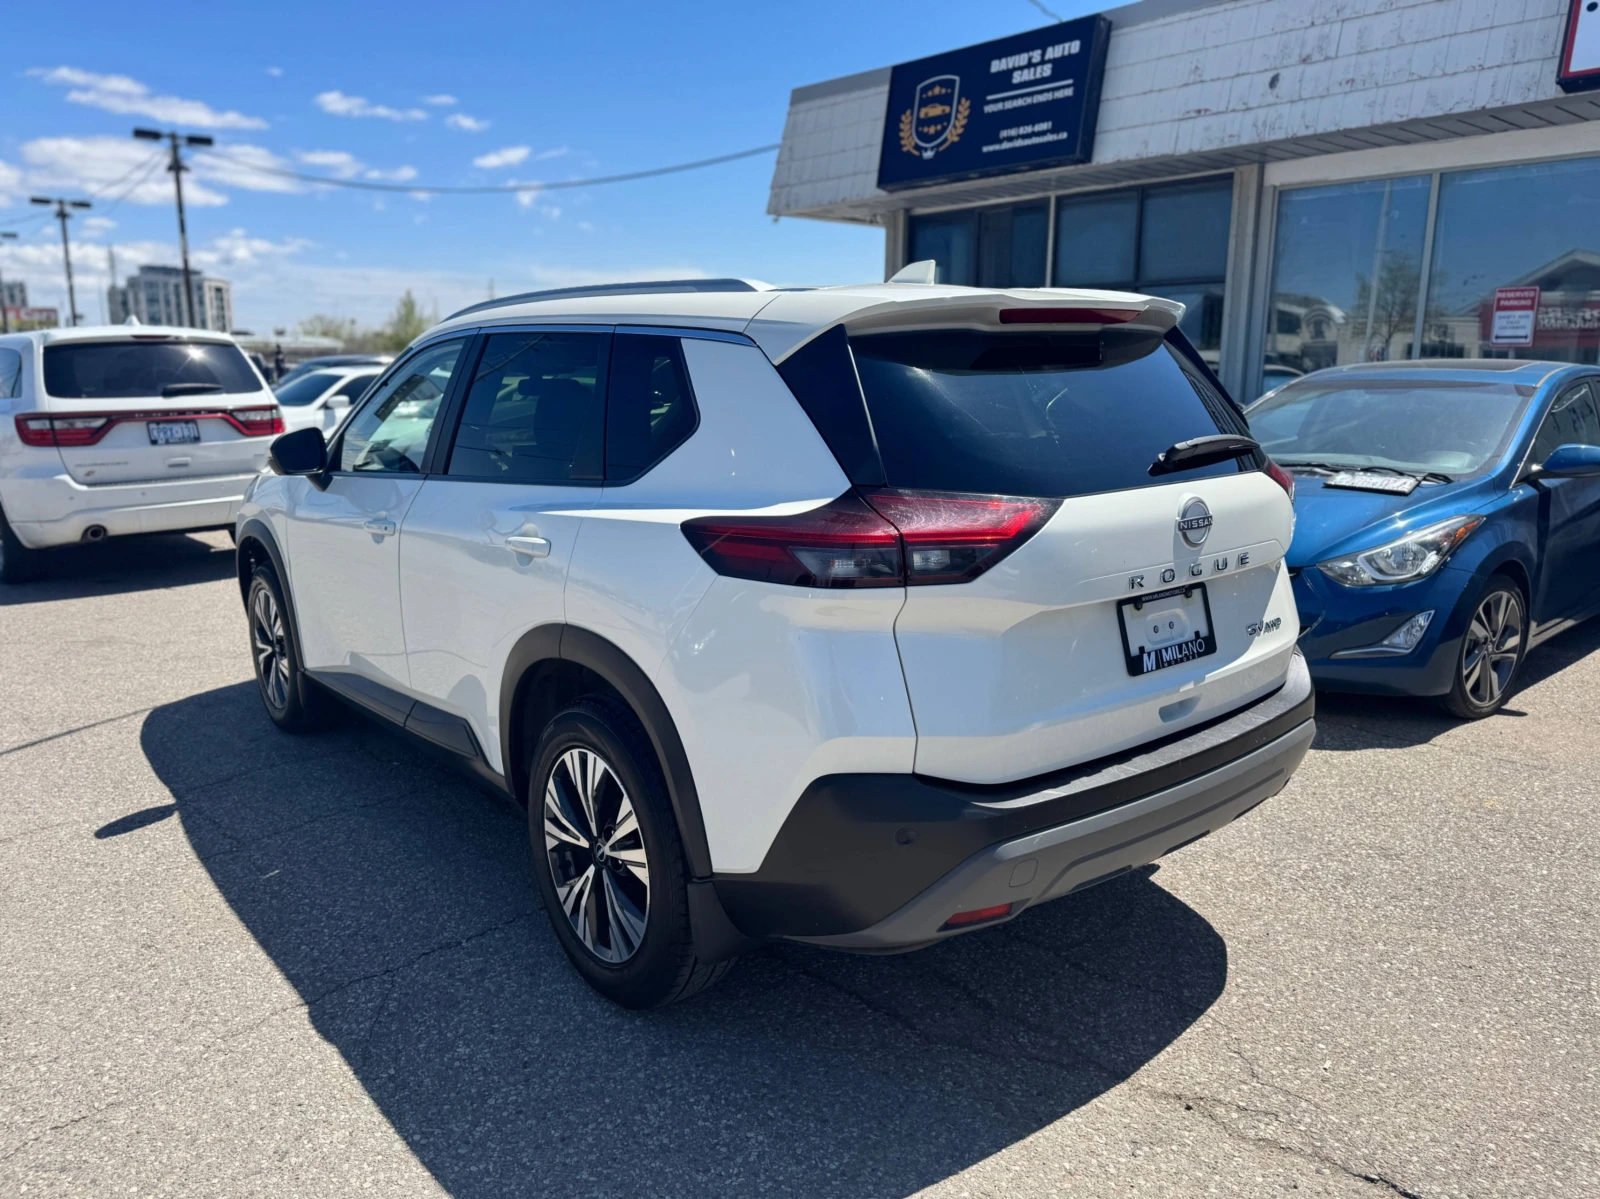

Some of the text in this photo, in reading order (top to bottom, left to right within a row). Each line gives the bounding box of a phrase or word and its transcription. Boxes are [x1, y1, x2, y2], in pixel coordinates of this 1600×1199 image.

[990, 40, 1080, 73] DAVID'S AUTO
[1012, 63, 1052, 84] SALES
[983, 86, 1074, 114] YOUR SEARCH ENDS HERE
[1496, 290, 1535, 299] RESERVED
[1500, 299, 1532, 307] PARKING
[1179, 516, 1213, 531] NISSAN
[1128, 552, 1249, 590] ROGUE
[1246, 617, 1282, 636] SV AWD
[1143, 638, 1205, 673] M MILANO
